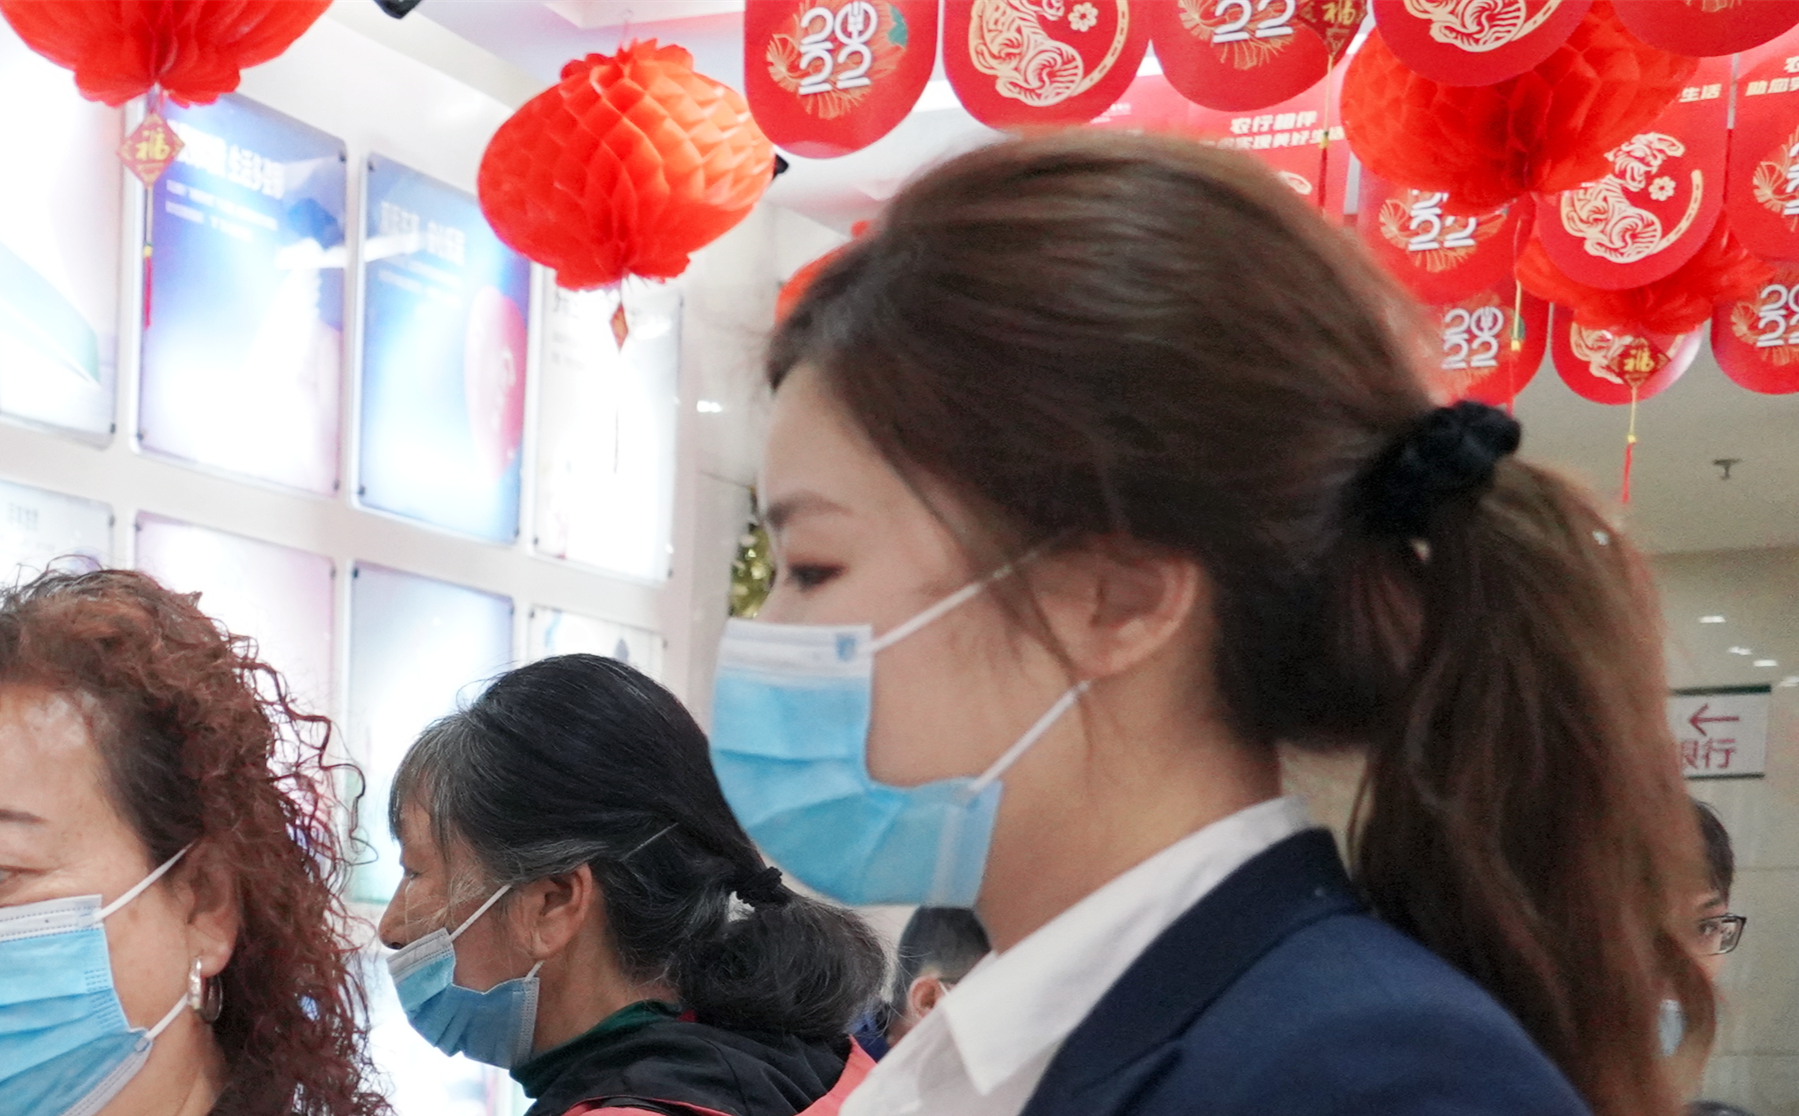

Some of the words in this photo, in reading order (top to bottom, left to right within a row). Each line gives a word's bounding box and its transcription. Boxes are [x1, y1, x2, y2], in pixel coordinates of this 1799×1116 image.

[1229, 111, 1319, 135] 农行相伴
[134, 126, 171, 161] 福
